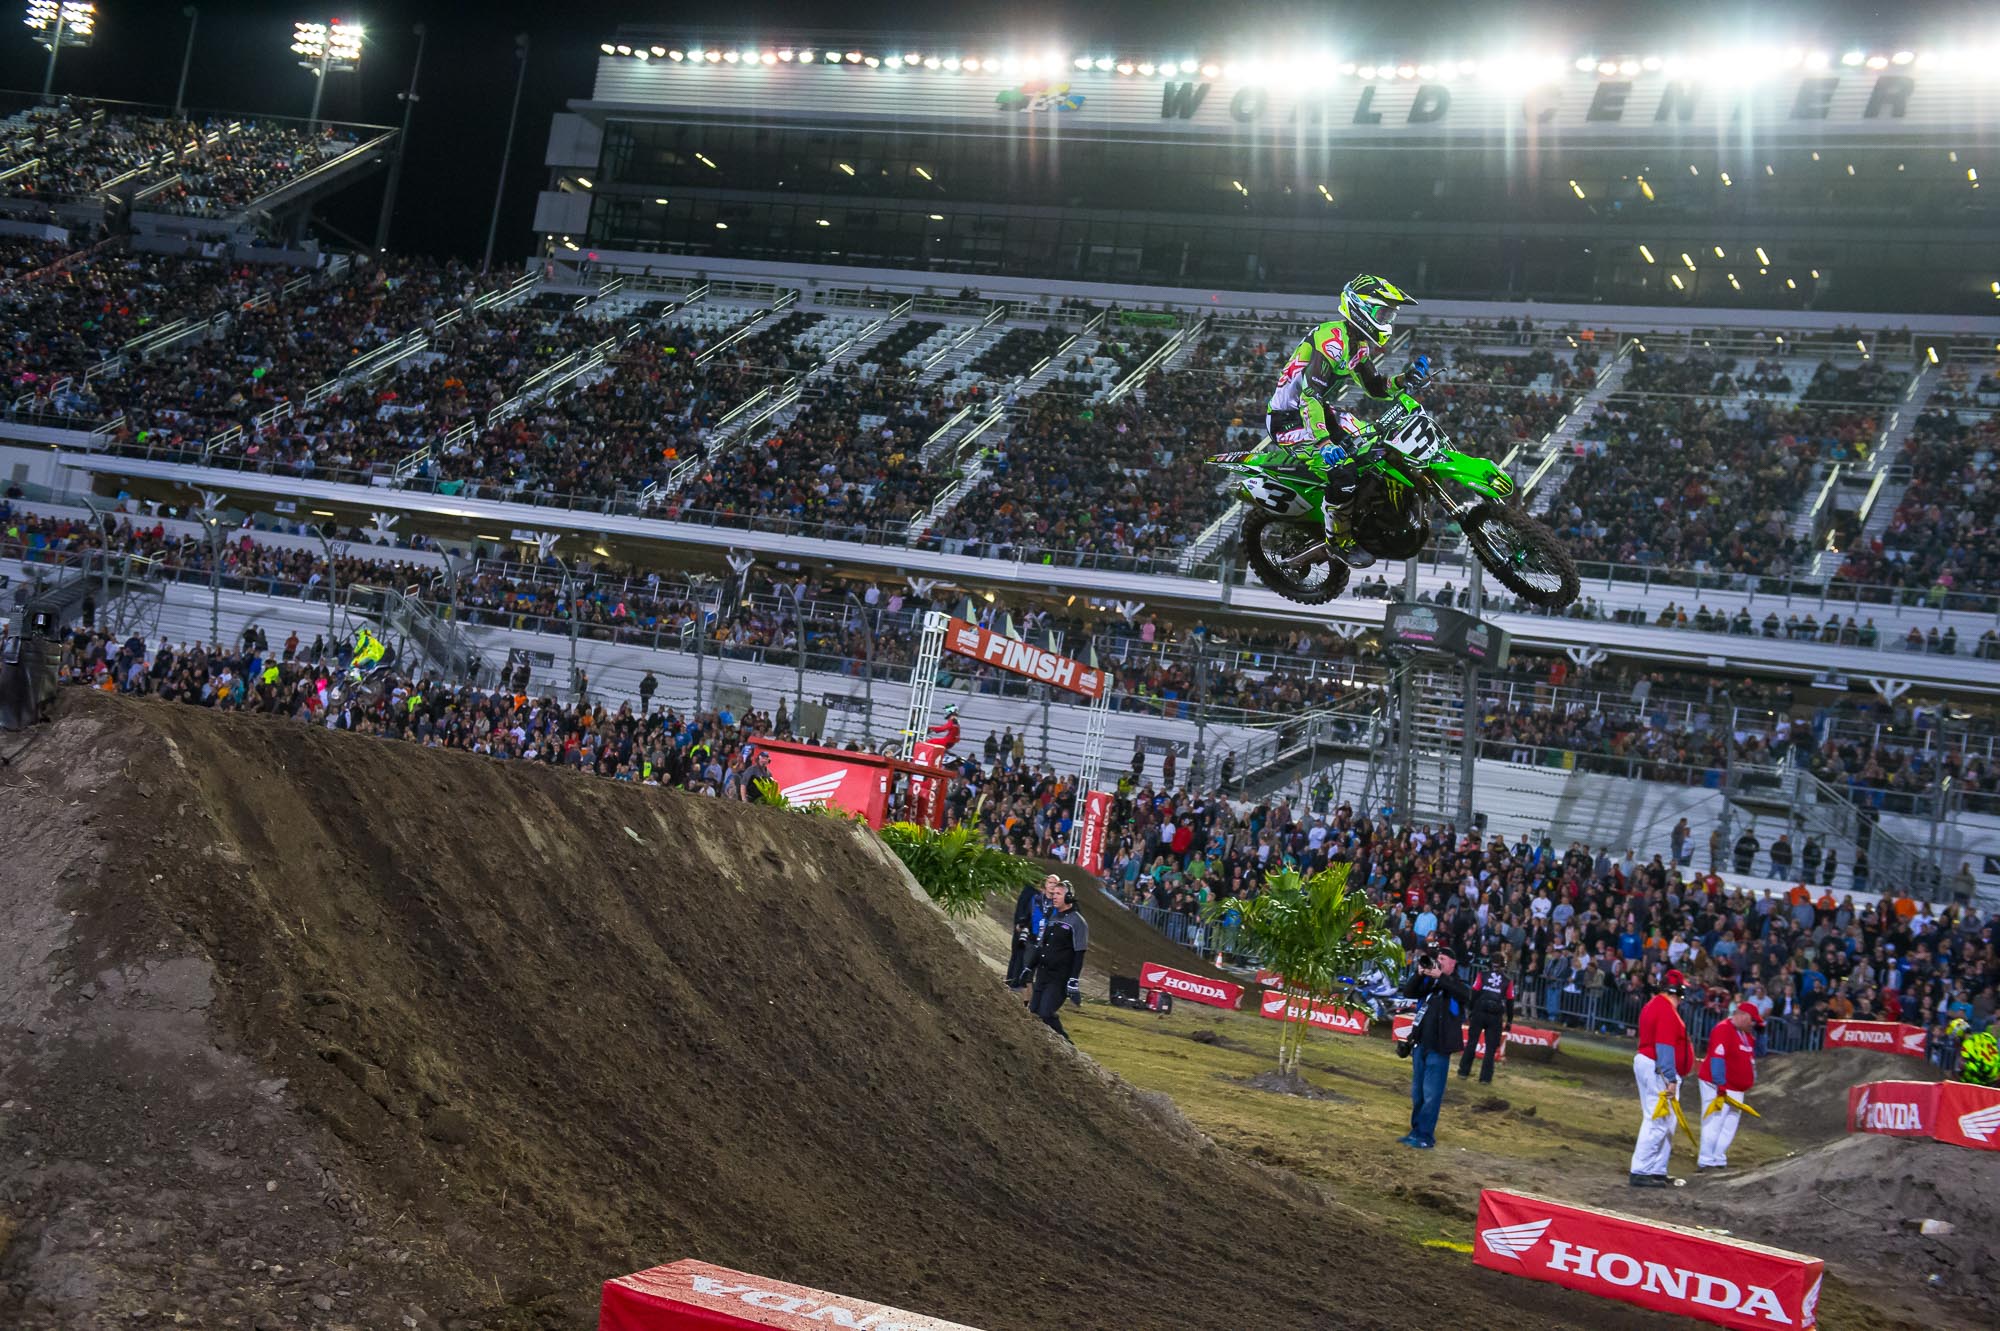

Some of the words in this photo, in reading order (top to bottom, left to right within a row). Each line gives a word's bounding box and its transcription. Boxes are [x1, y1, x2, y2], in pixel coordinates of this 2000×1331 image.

[1522, 75, 1916, 123] CENER
[1400, 415, 1437, 461] 3
[1255, 482, 1297, 514] 3
[984, 634, 1075, 686] FINISH
[1082, 814, 1096, 867] HONDA
[1164, 976, 1227, 1000] HONDA
[1286, 1006, 1362, 1030] HONDA
[1844, 1030, 1894, 1043] HONDA
[1505, 1033, 1549, 1046] ONDA
[1546, 1239, 1793, 1325] HONDA
